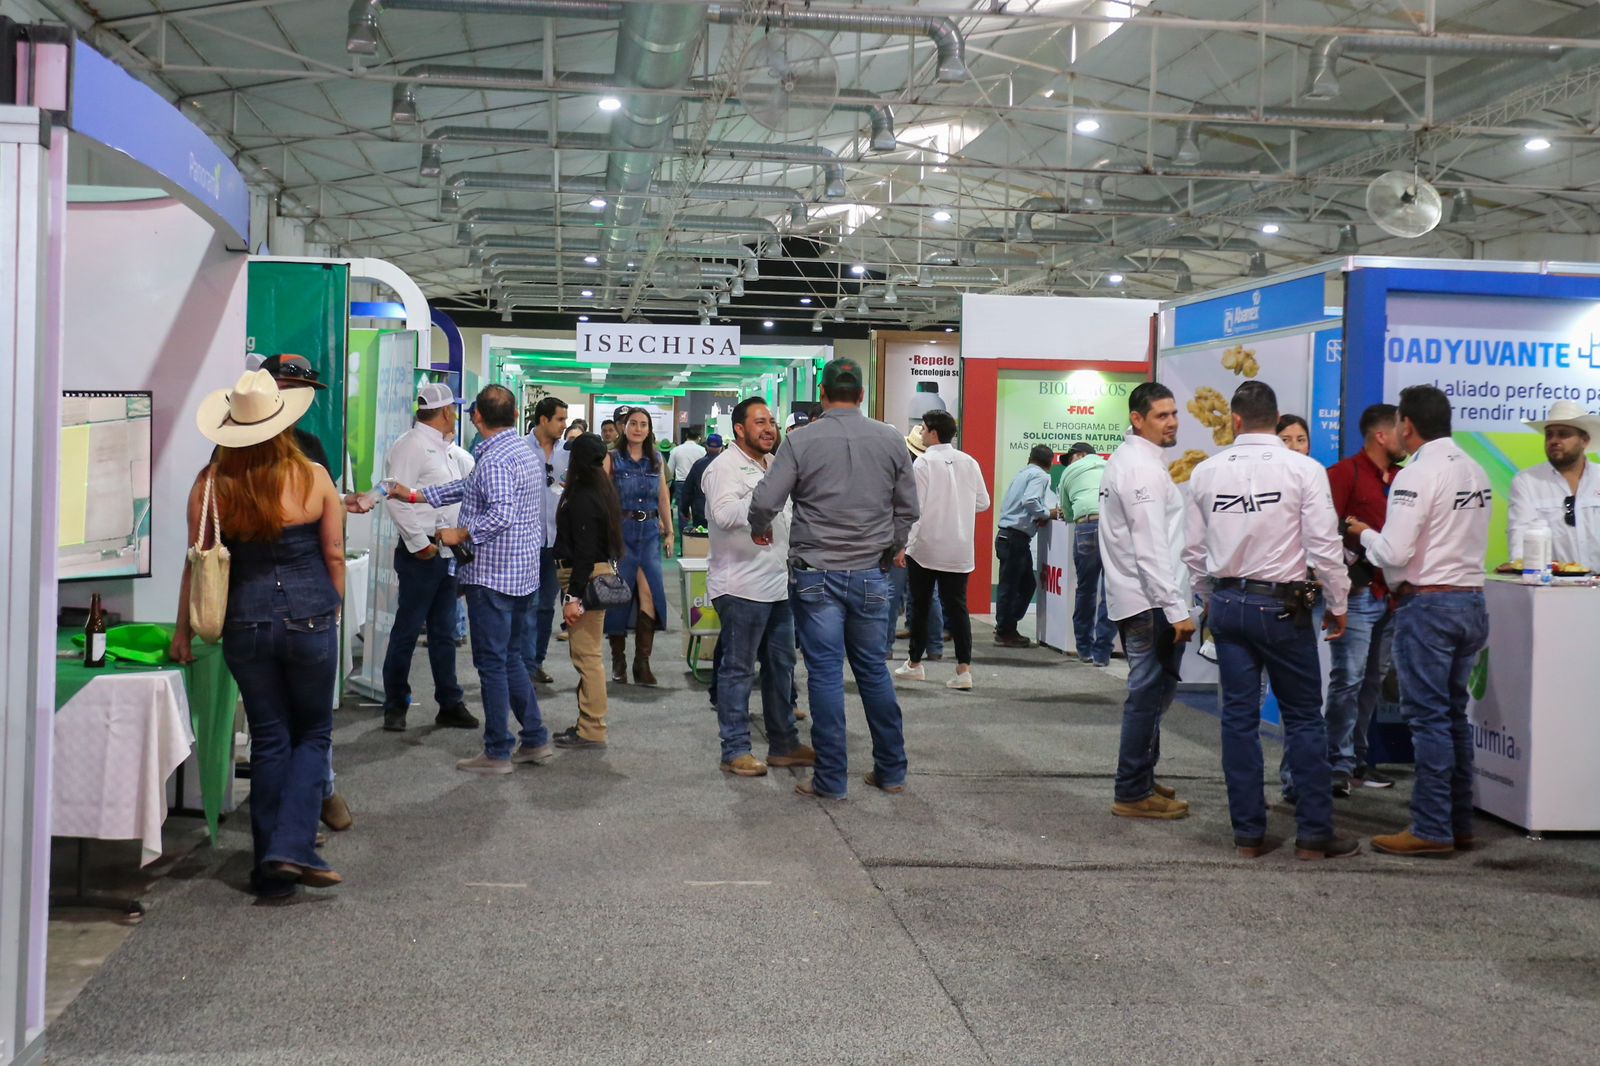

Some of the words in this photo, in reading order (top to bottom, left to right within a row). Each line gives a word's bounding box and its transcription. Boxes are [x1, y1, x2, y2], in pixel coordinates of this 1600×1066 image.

[584, 334, 737, 356] ISECHISA
[914, 355, 955, 367] Repele
[1446, 381, 1500, 398] aliado
[1506, 382, 1581, 401] perfecto
[1067, 406, 1095, 415] FMC
[1461, 405, 1515, 421] rendir
[1520, 406, 1536, 421] tu
[1043, 422, 1054, 430] EL
[1056, 422, 1106, 431] PROGRAMA
[1023, 432, 1083, 441] SOLUCIONES
